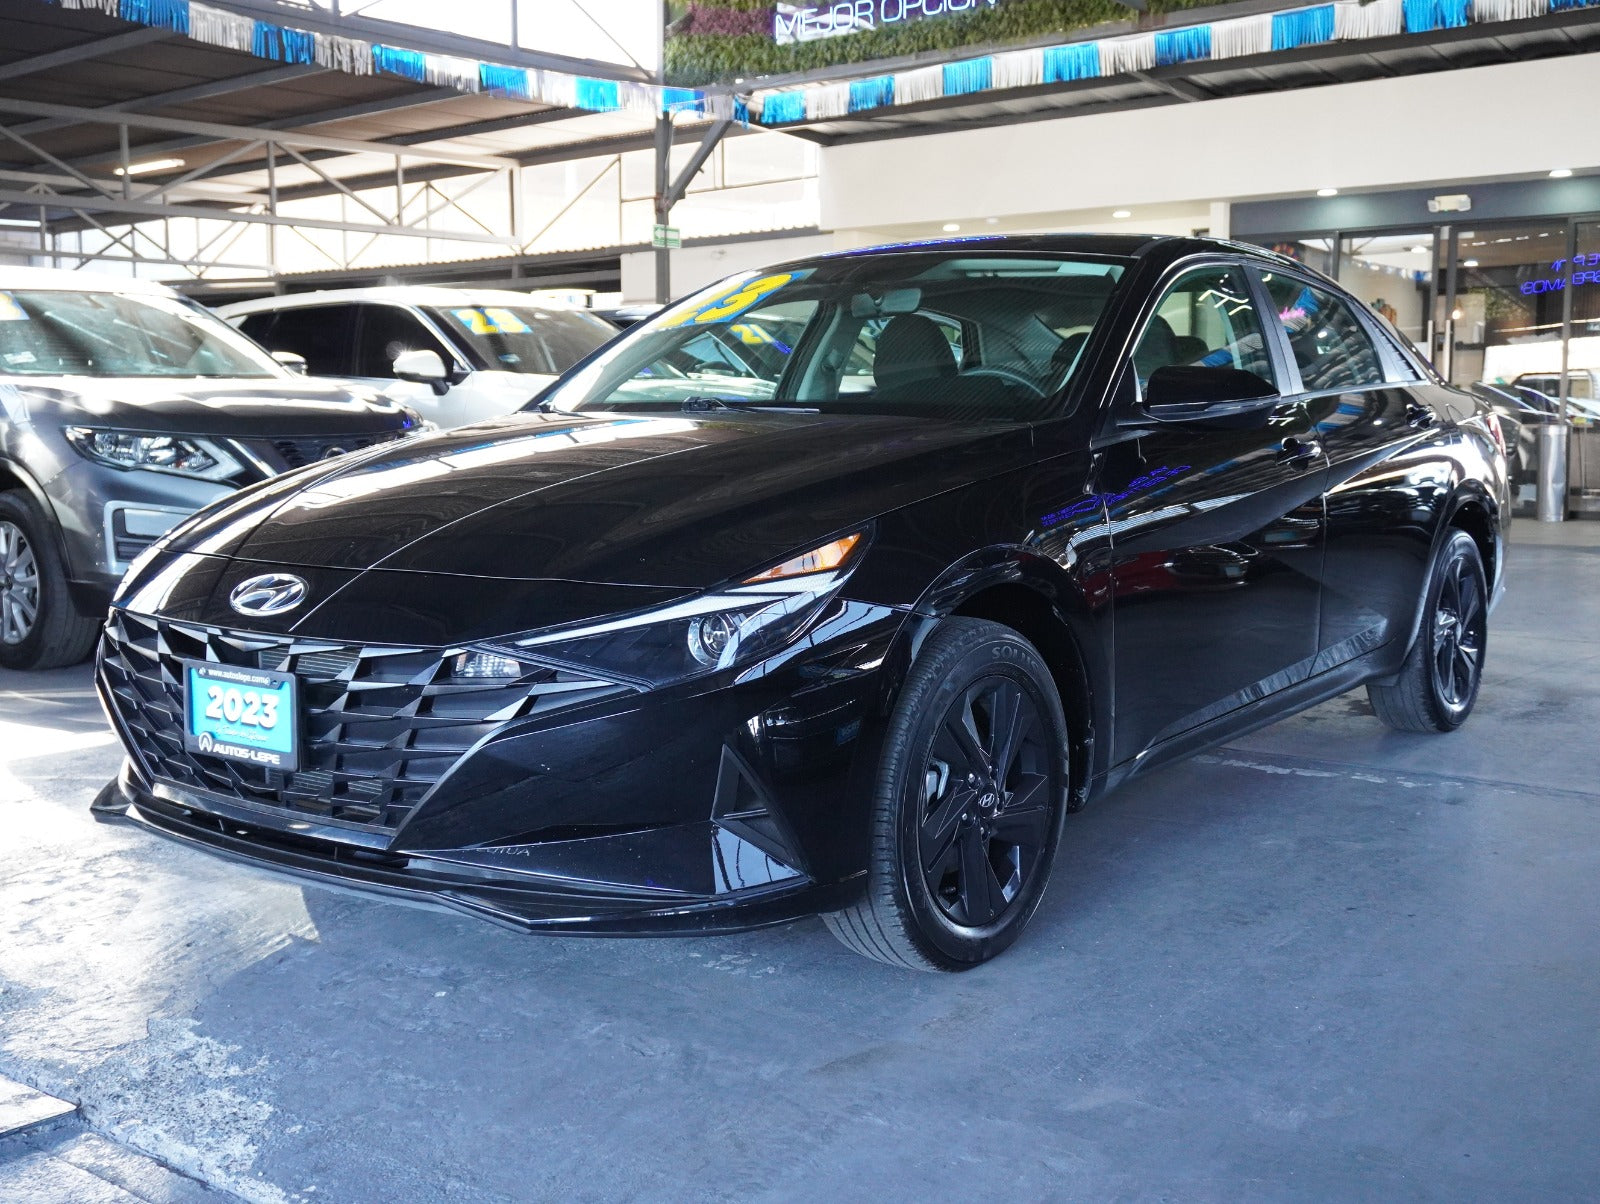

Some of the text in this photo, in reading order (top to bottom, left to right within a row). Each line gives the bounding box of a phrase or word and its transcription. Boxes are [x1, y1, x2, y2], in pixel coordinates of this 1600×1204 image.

[774, 0, 997, 42] MEJOR OPC
[205, 684, 279, 729] 2023
